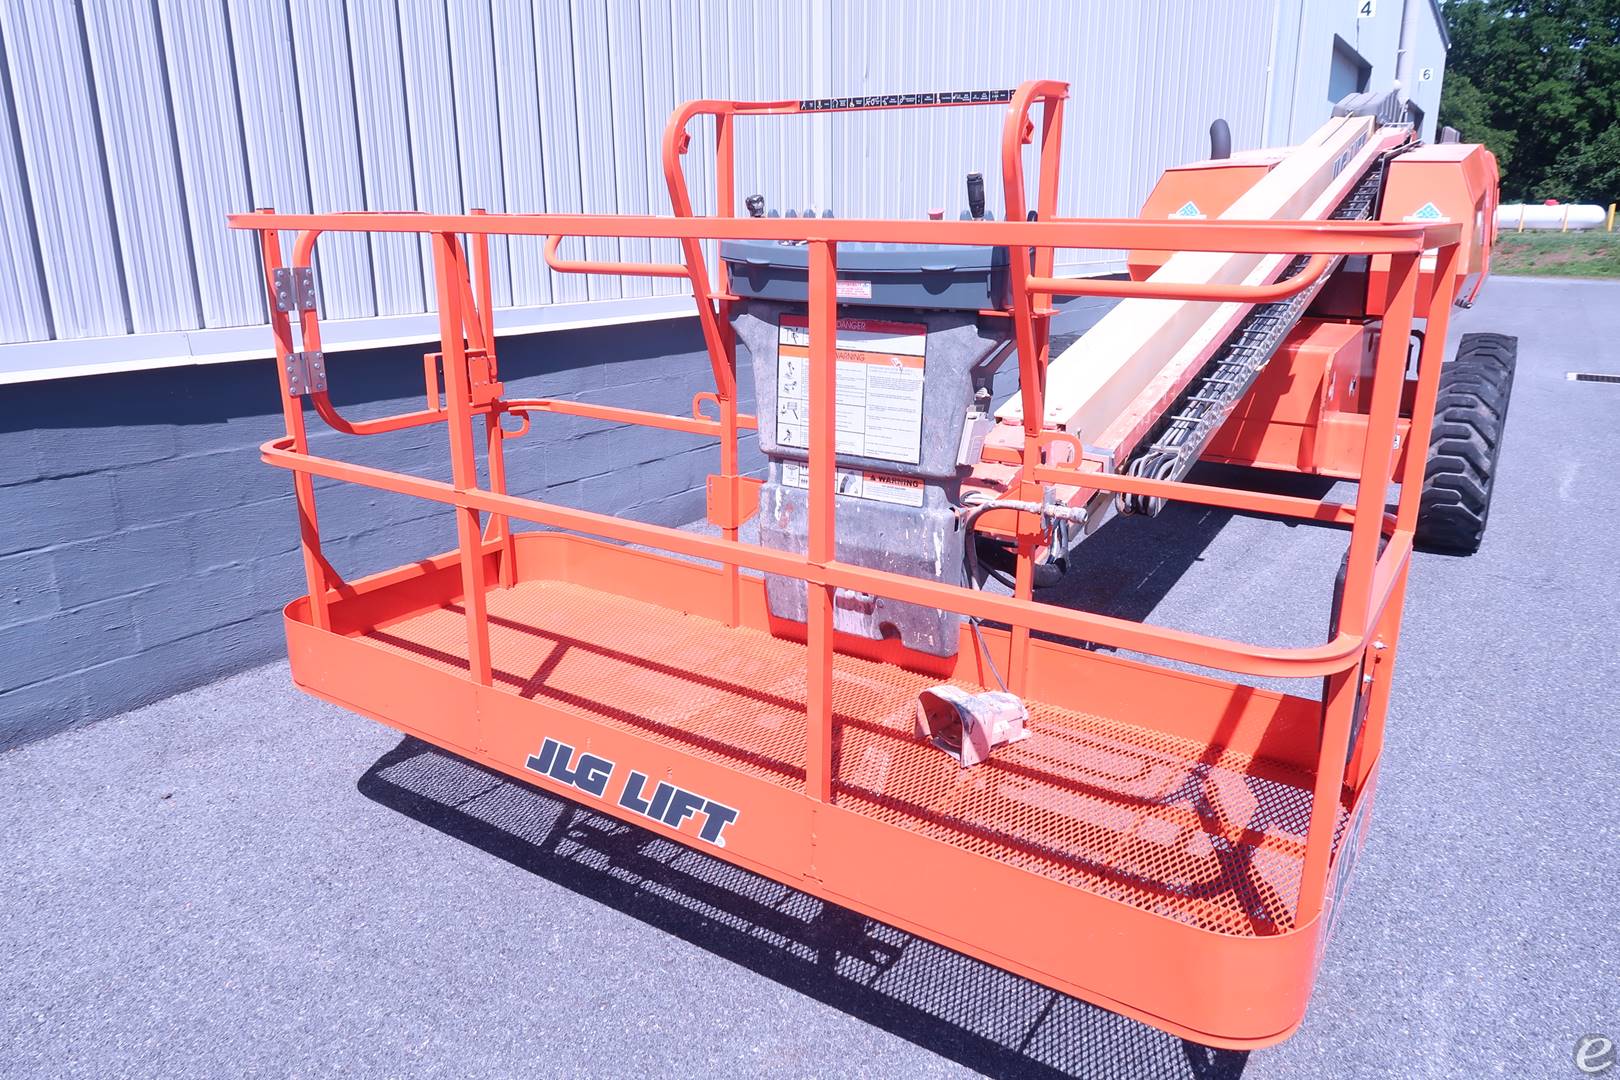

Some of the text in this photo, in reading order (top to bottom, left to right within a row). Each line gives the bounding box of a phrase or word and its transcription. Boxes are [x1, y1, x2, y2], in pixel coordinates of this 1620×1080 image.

[1360, 0, 1372, 16] 4
[1423, 69, 1430, 80] 6
[836, 321, 865, 330] DANGER
[879, 476, 918, 487] WARNING
[525, 736, 740, 844] JLG LIFT
